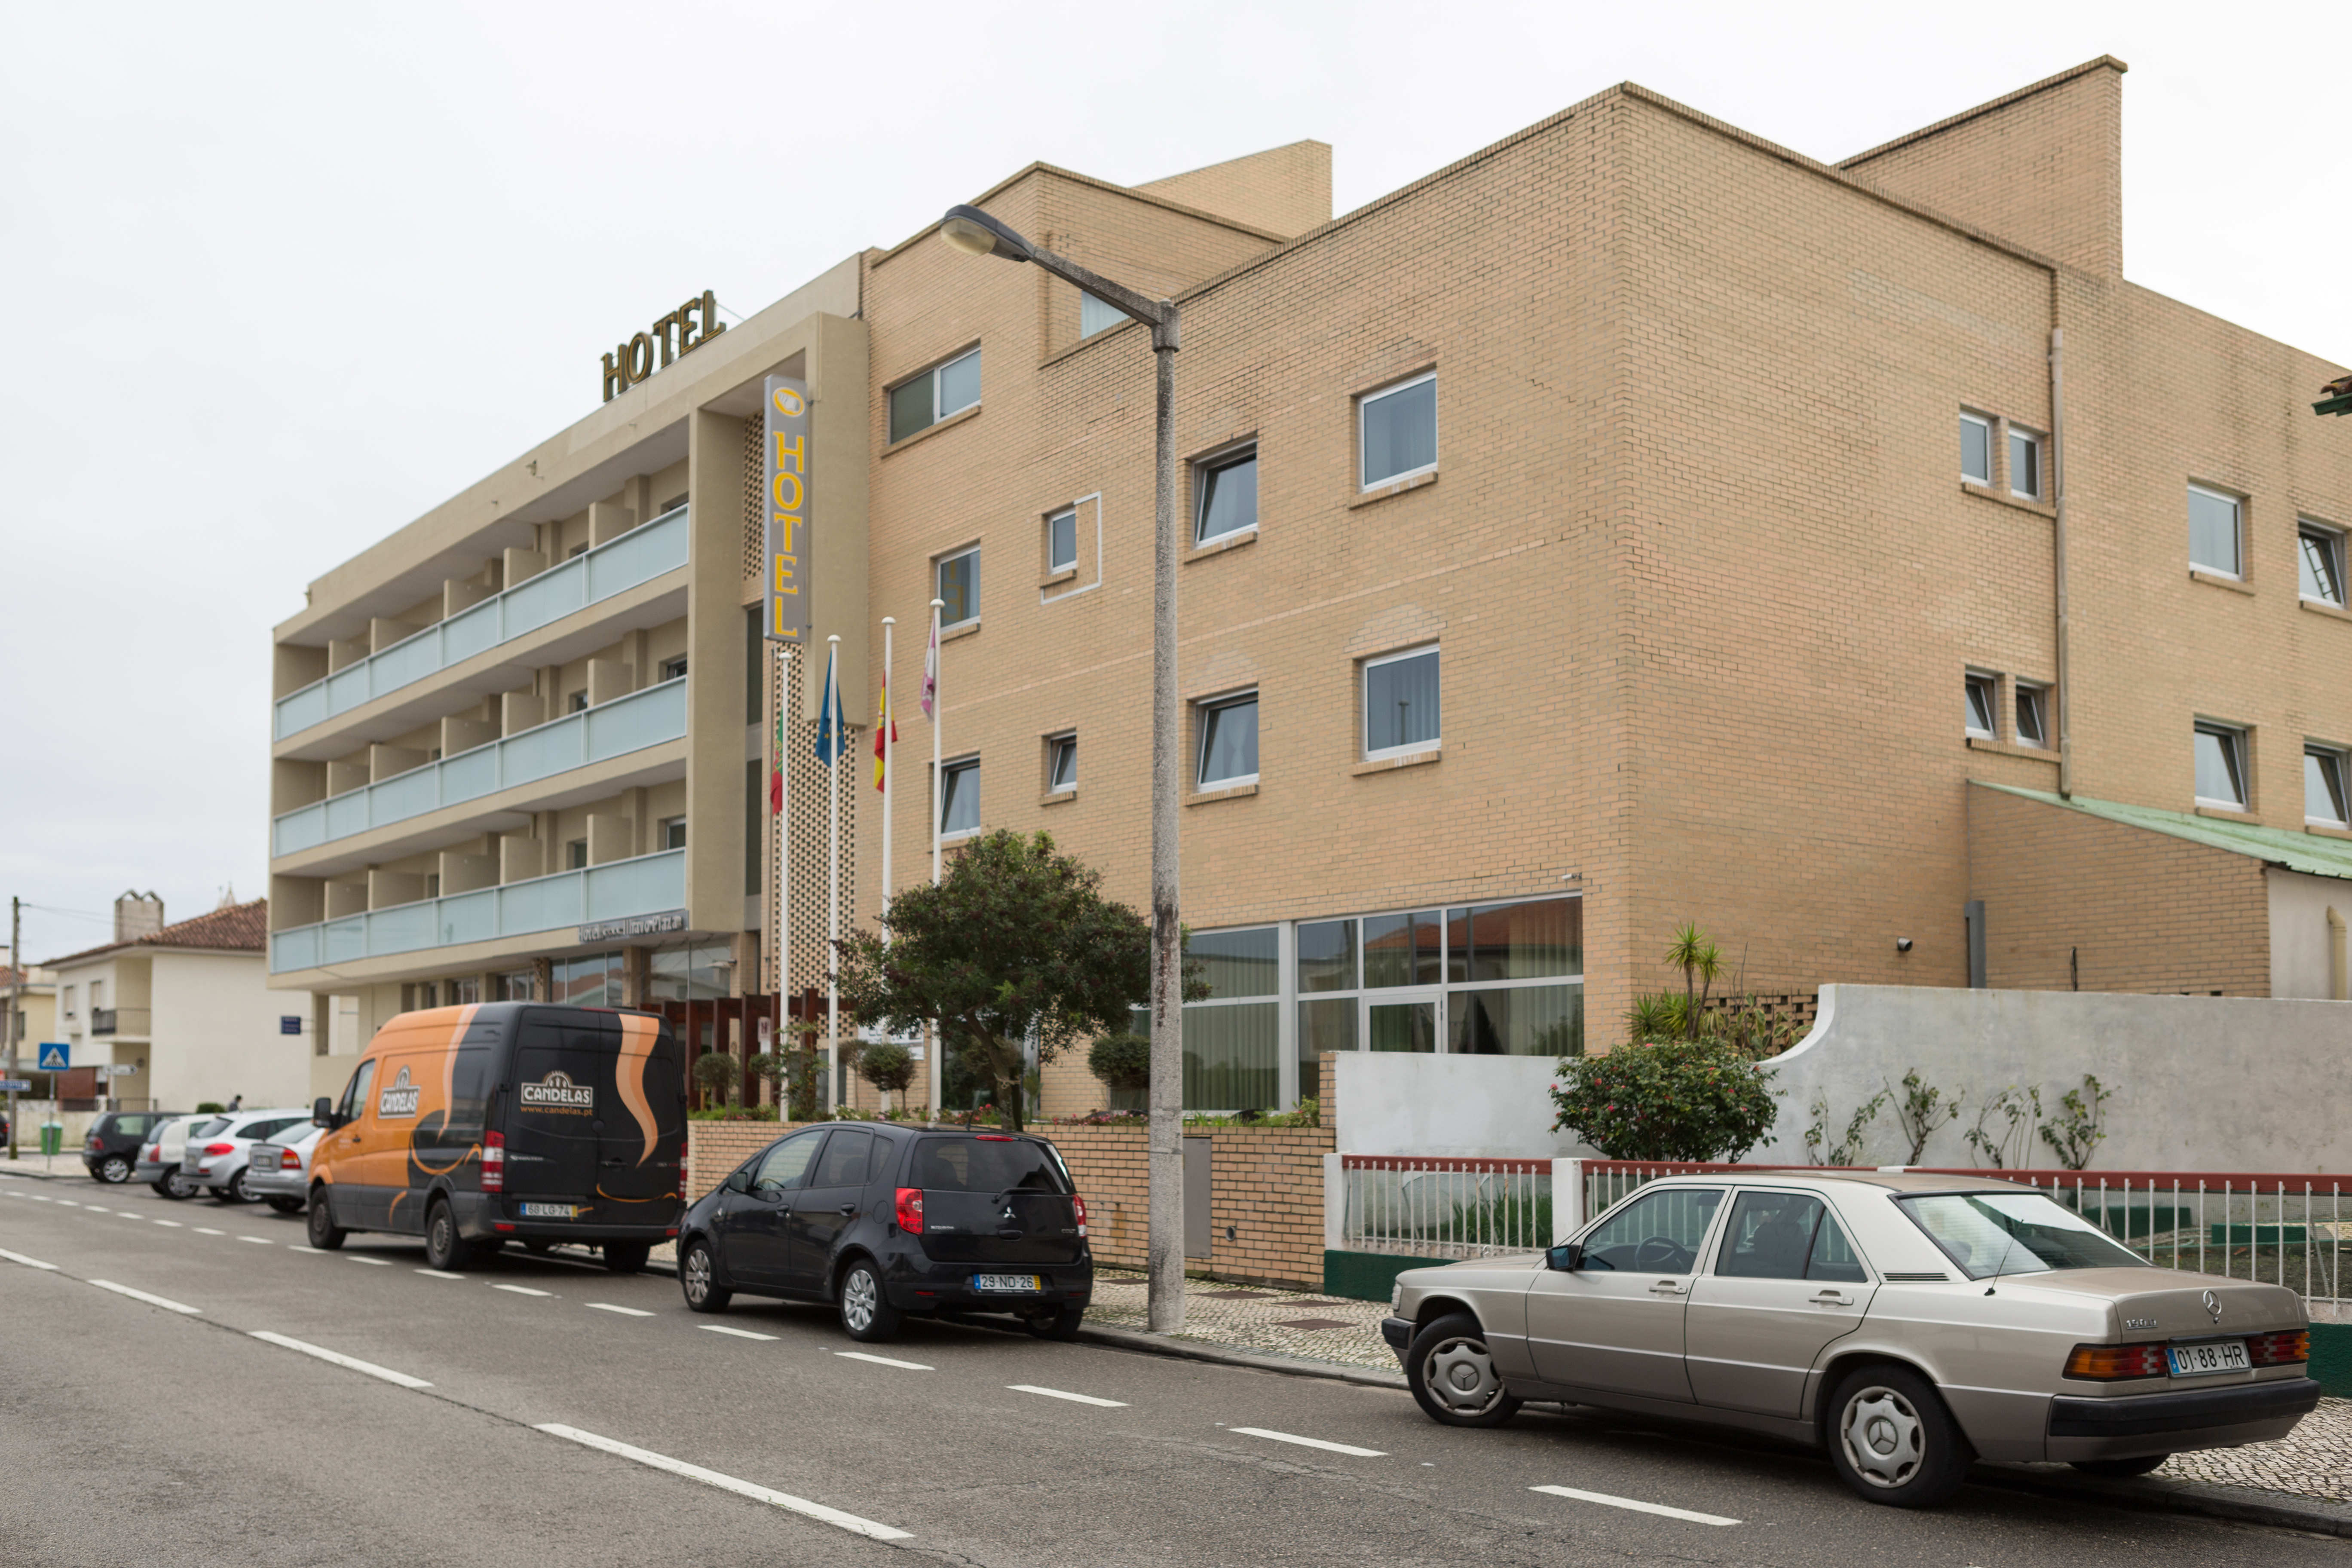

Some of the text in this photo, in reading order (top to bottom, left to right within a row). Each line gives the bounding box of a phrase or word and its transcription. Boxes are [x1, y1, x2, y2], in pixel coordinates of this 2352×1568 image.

[600, 290, 726, 402] HOTEL
[772, 430, 804, 637] HOTEL
[652, 915, 681, 932] Plaza
[380, 1091, 418, 1113] CANDELAS
[524, 1086, 590, 1104] CANDELAS
[520, 1106, 593, 1118] www.candelas.pt
